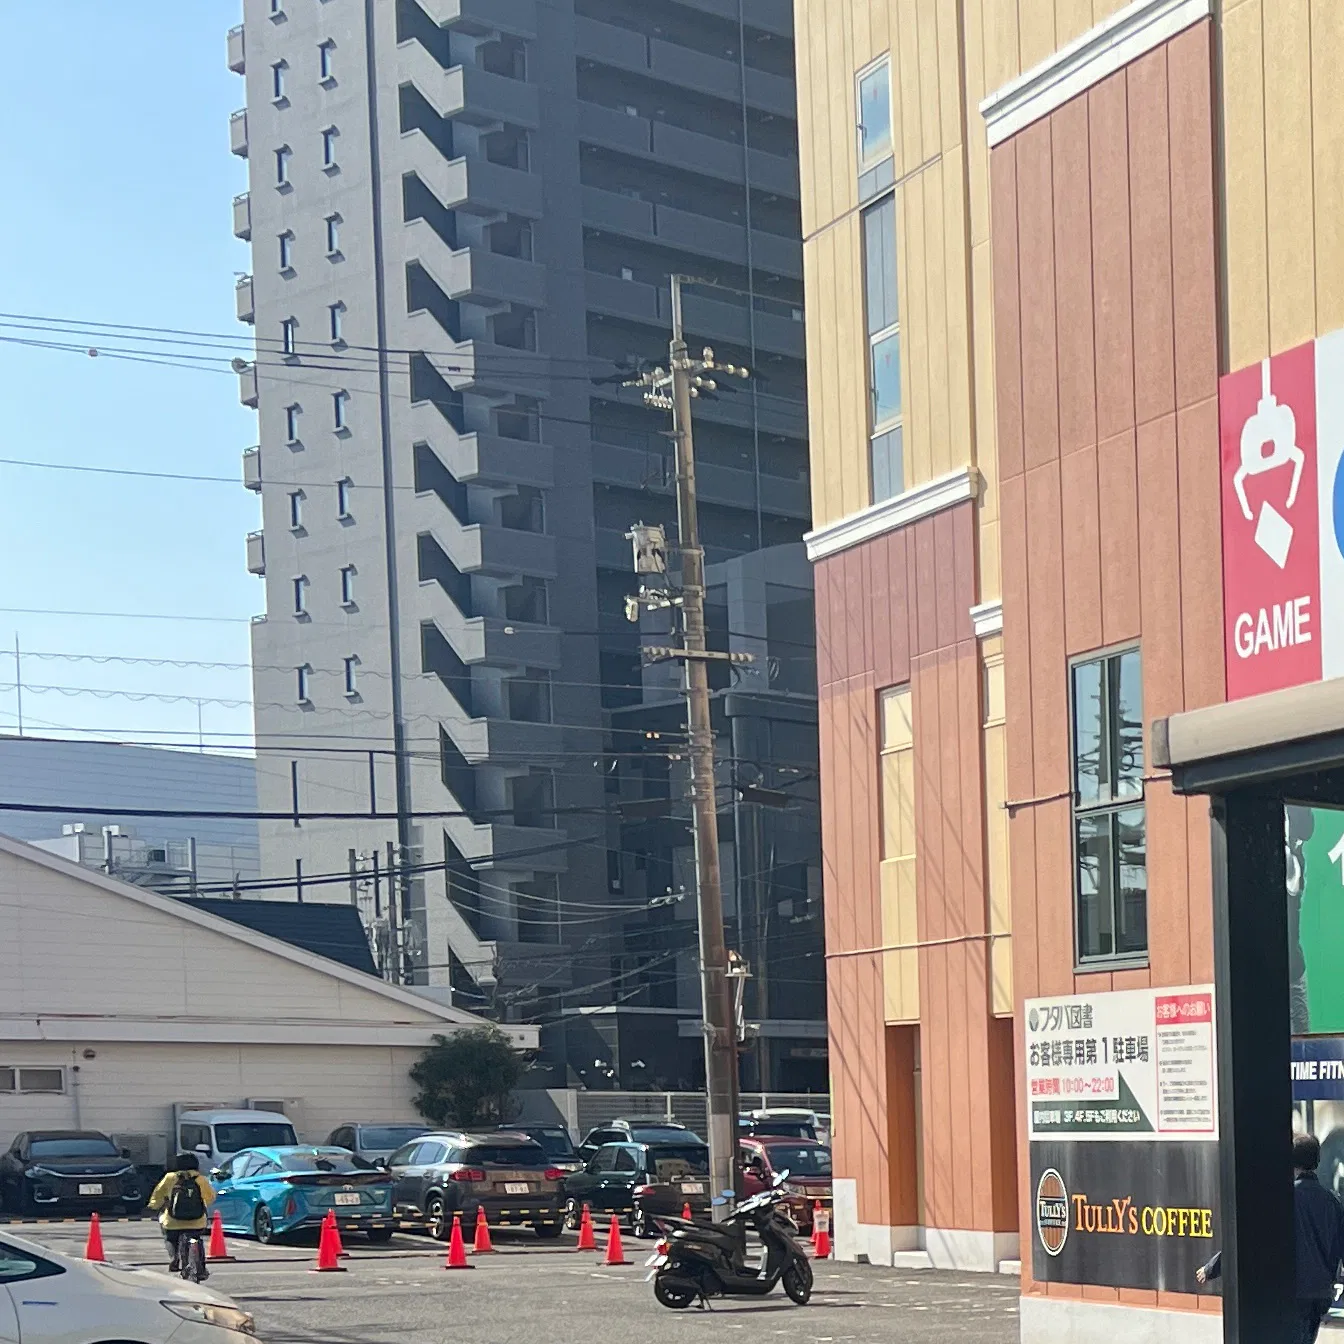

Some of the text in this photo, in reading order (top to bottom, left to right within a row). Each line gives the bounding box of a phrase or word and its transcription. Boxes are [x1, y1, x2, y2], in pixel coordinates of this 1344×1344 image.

[1234, 596, 1312, 658] GAME
[1039, 1003, 1094, 1032] フタバ図書
[1290, 1061, 1318, 1080] TIME
[1141, 1206, 1214, 1238] COFFEE
